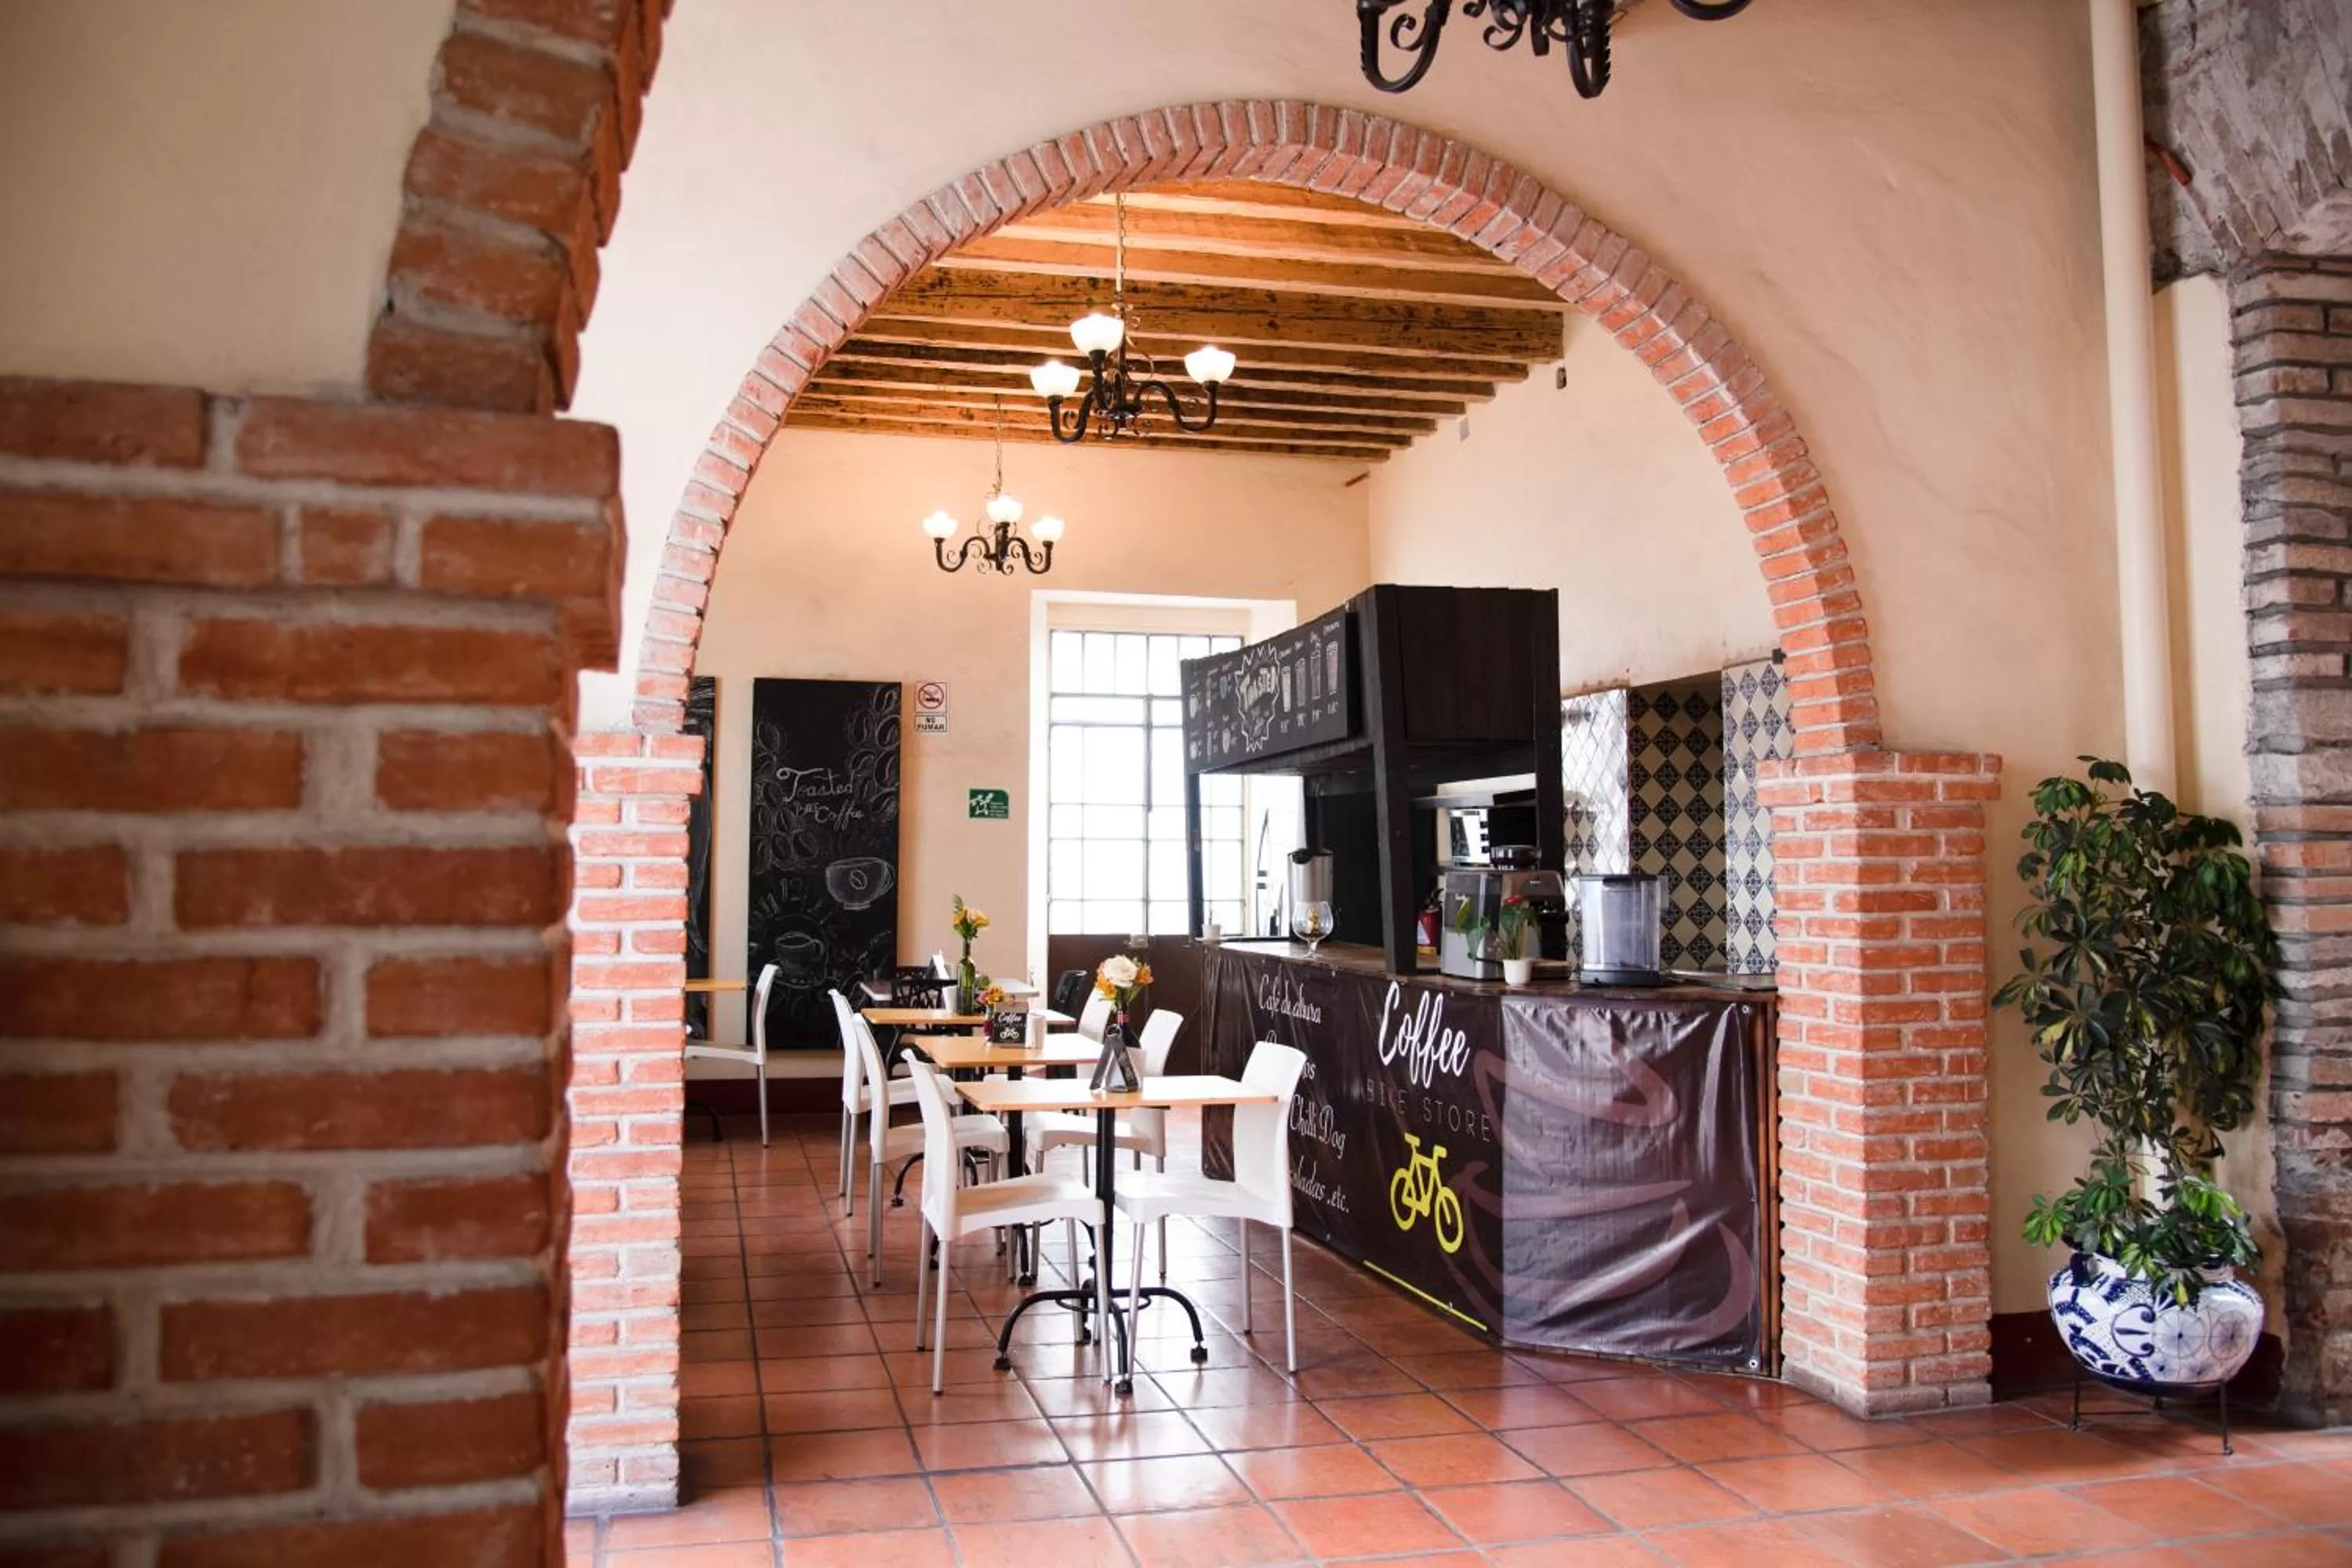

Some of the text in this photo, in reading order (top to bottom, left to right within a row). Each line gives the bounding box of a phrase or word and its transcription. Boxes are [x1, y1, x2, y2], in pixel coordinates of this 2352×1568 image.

[998, 1011, 1022, 1024] Coffee
[1258, 974, 1280, 1018] Café
[1377, 981, 1471, 1090] Coffee
[1319, 1105, 1346, 1160] Dog
[1367, 1078, 1491, 1142] BIE STORE
